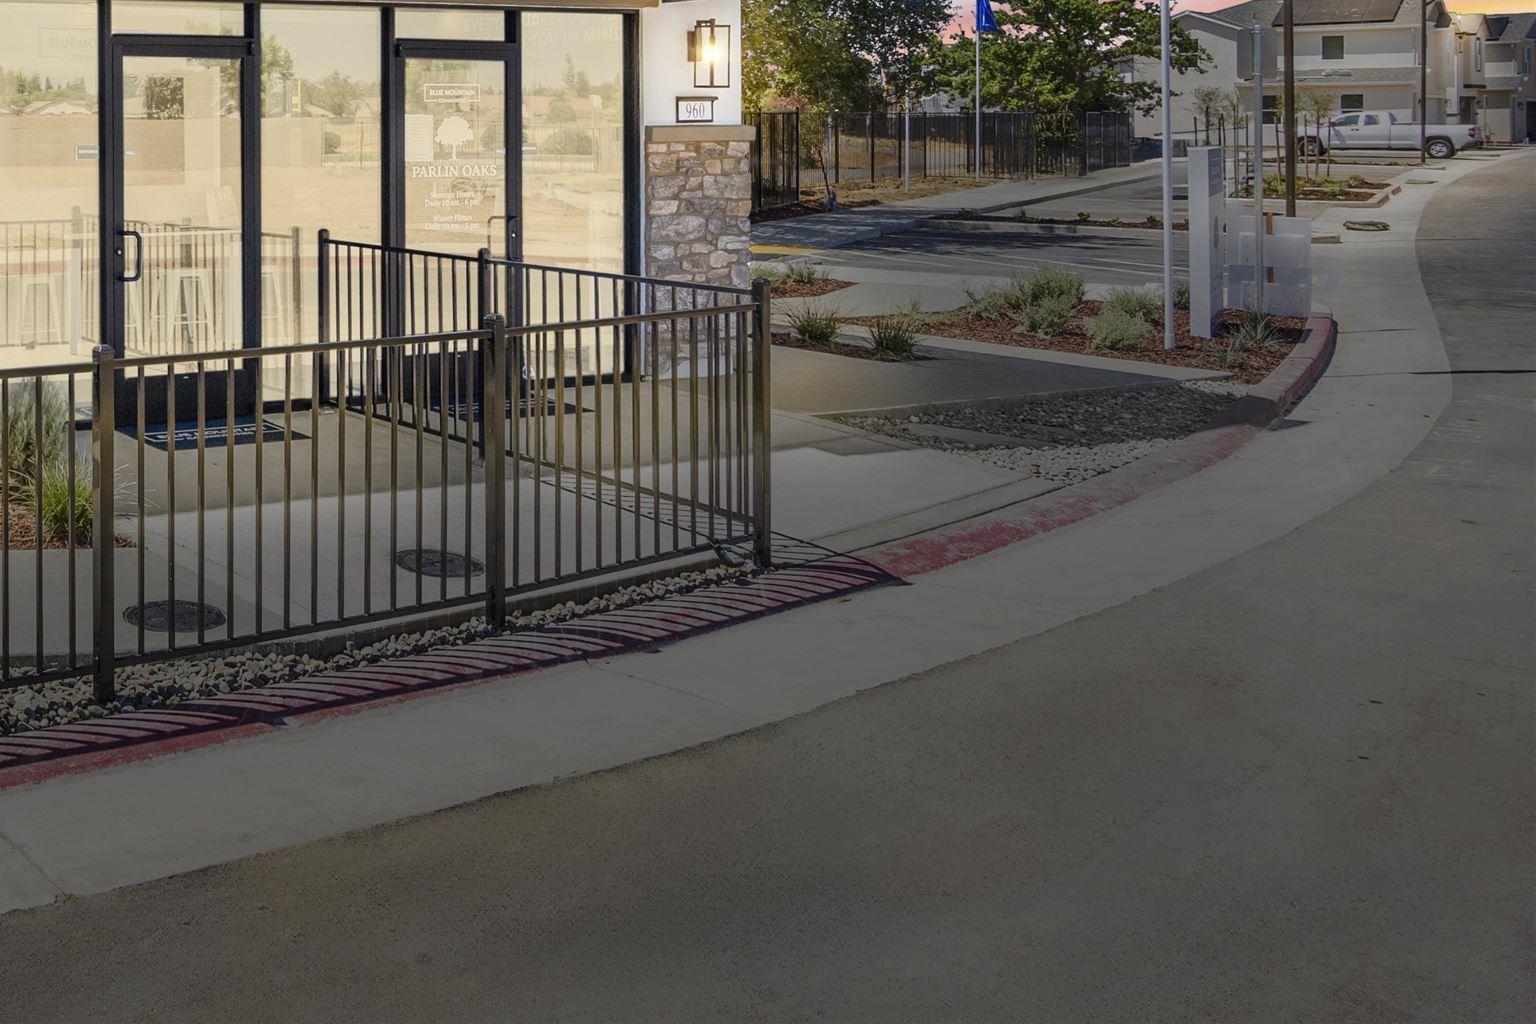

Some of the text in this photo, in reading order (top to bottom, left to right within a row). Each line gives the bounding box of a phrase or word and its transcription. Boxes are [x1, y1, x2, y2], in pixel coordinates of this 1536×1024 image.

[686, 103, 705, 118] 960
[412, 165, 497, 178] PARLIN OAKS
